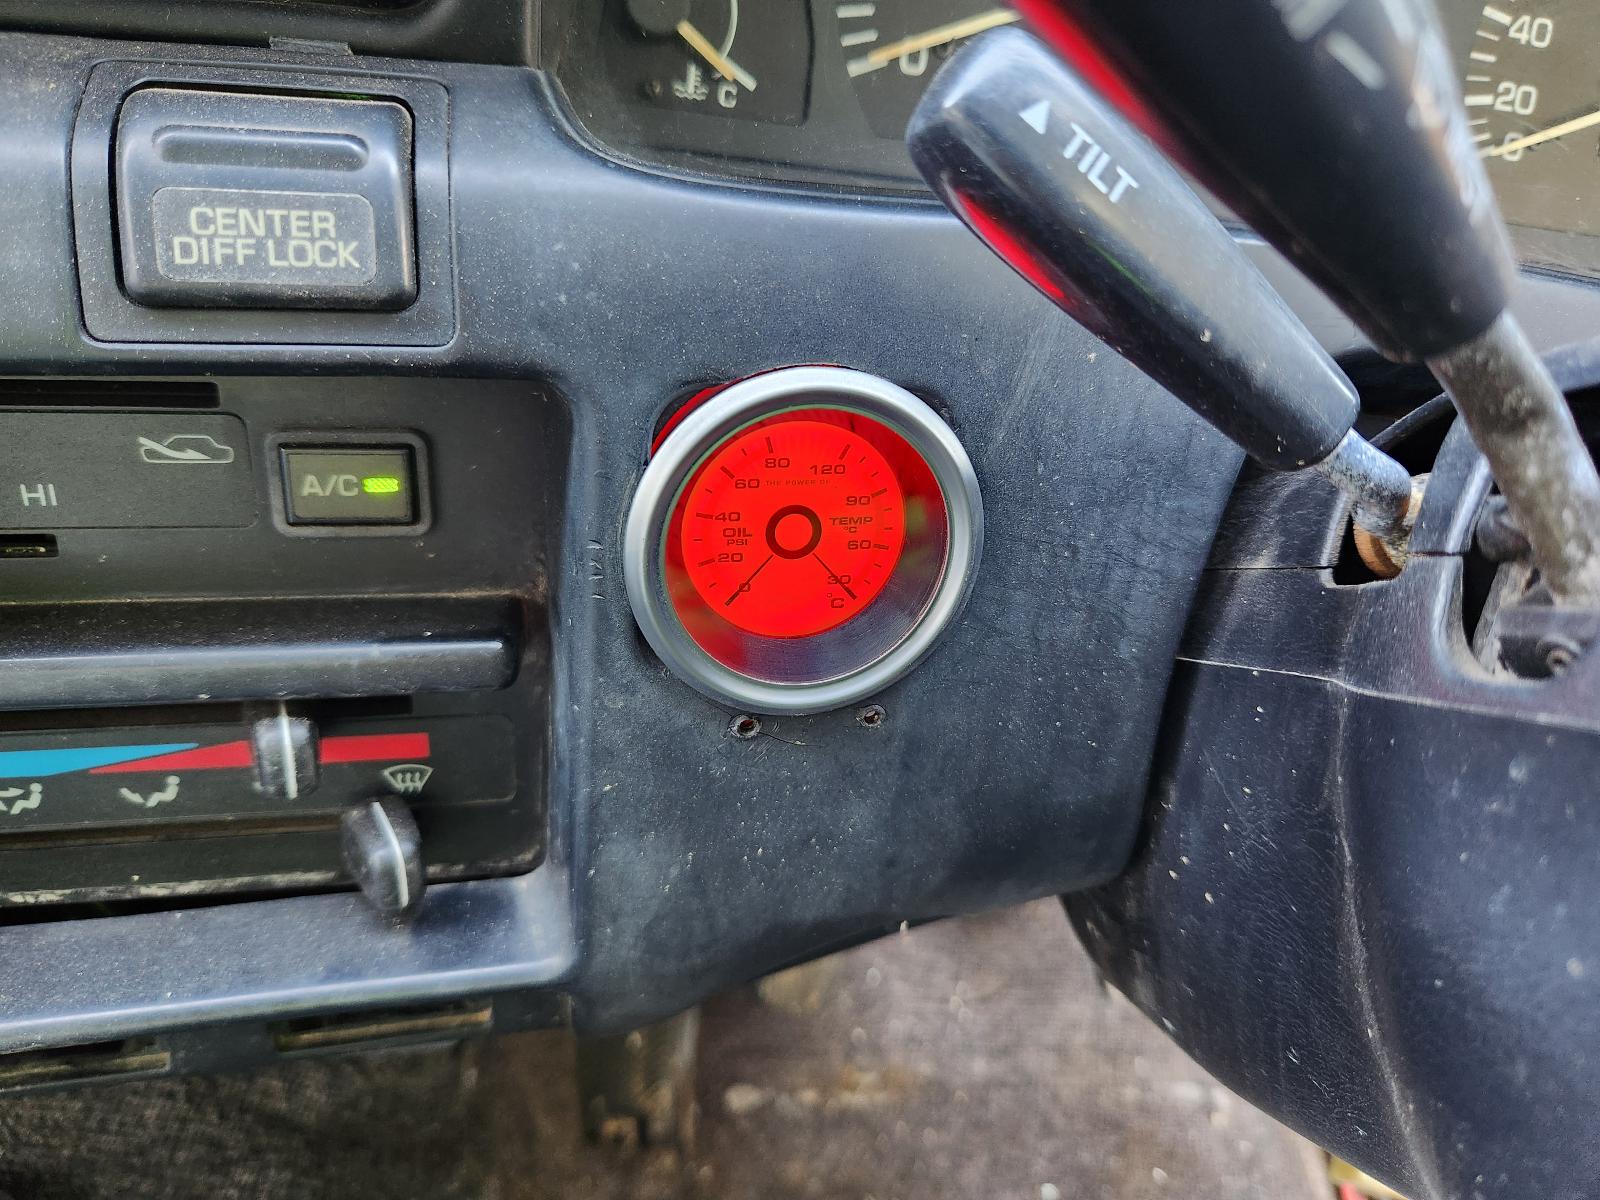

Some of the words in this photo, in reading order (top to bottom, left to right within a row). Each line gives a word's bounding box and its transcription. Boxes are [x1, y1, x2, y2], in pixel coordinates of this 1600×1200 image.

[1508, 14, 1553, 48] 40
[717, 82, 738, 108] C
[1494, 81, 1538, 115] 20
[1502, 132, 1525, 162] 0
[1063, 122, 1138, 203] TILT
[189, 206, 336, 238] CENTER
[173, 236, 256, 266] DIFF
[267, 239, 360, 269] LOCK
[764, 457, 790, 469] 80
[809, 464, 846, 475] 120
[302, 473, 359, 497] A/C
[734, 479, 760, 489] 60
[19, 483, 58, 507] HI
[845, 495, 871, 505] 90
[714, 512, 741, 522] 40
[829, 516, 873, 525] TEMP
[722, 527, 752, 538] OIL
[847, 540, 871, 550] 60
[717, 552, 744, 563] 20
[827, 575, 851, 584] 30
